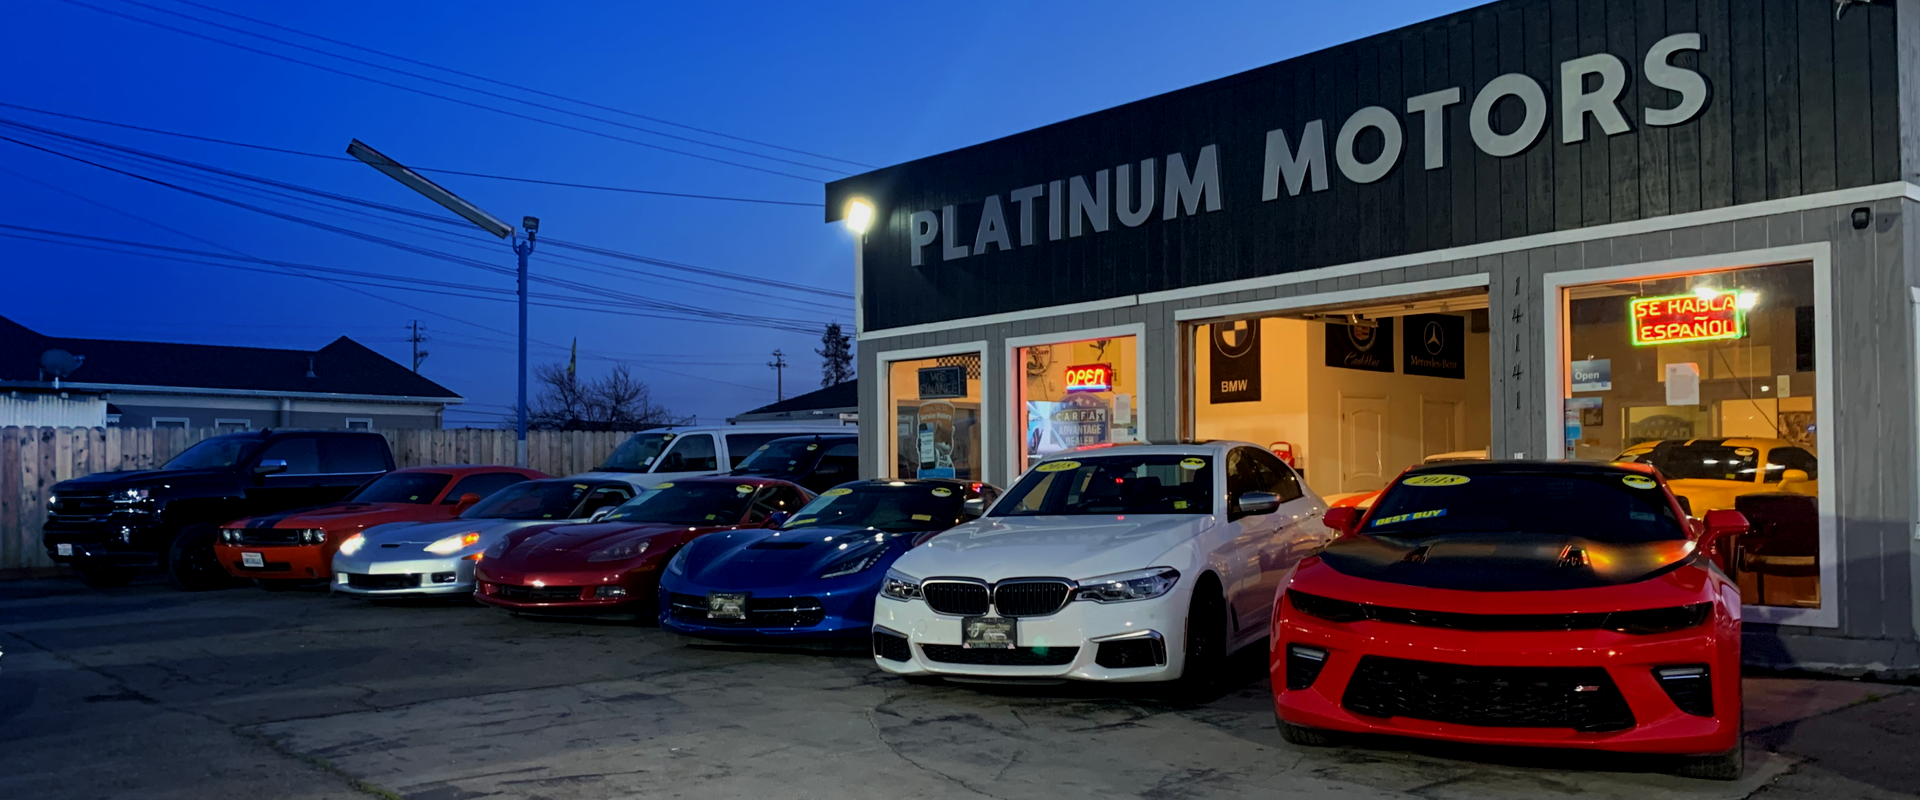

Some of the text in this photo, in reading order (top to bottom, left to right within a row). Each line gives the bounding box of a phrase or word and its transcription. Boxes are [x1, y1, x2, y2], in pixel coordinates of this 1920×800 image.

[910, 32, 1709, 267] PLATINUM MOTORS
[1636, 296, 1736, 317] SE HABLA
[1641, 316, 1735, 340] ESPAÑOL
[1066, 369, 1106, 386] OPEN
[1574, 371, 1600, 382] Open
[1221, 379, 1248, 393] BMW
[1055, 410, 1105, 421] CARFAX
[1058, 424, 1103, 435] ADVANTAGE
[1065, 435, 1095, 446] DEALER
[1412, 475, 1461, 485] 2018
[1375, 509, 1443, 526] BEST BUY
